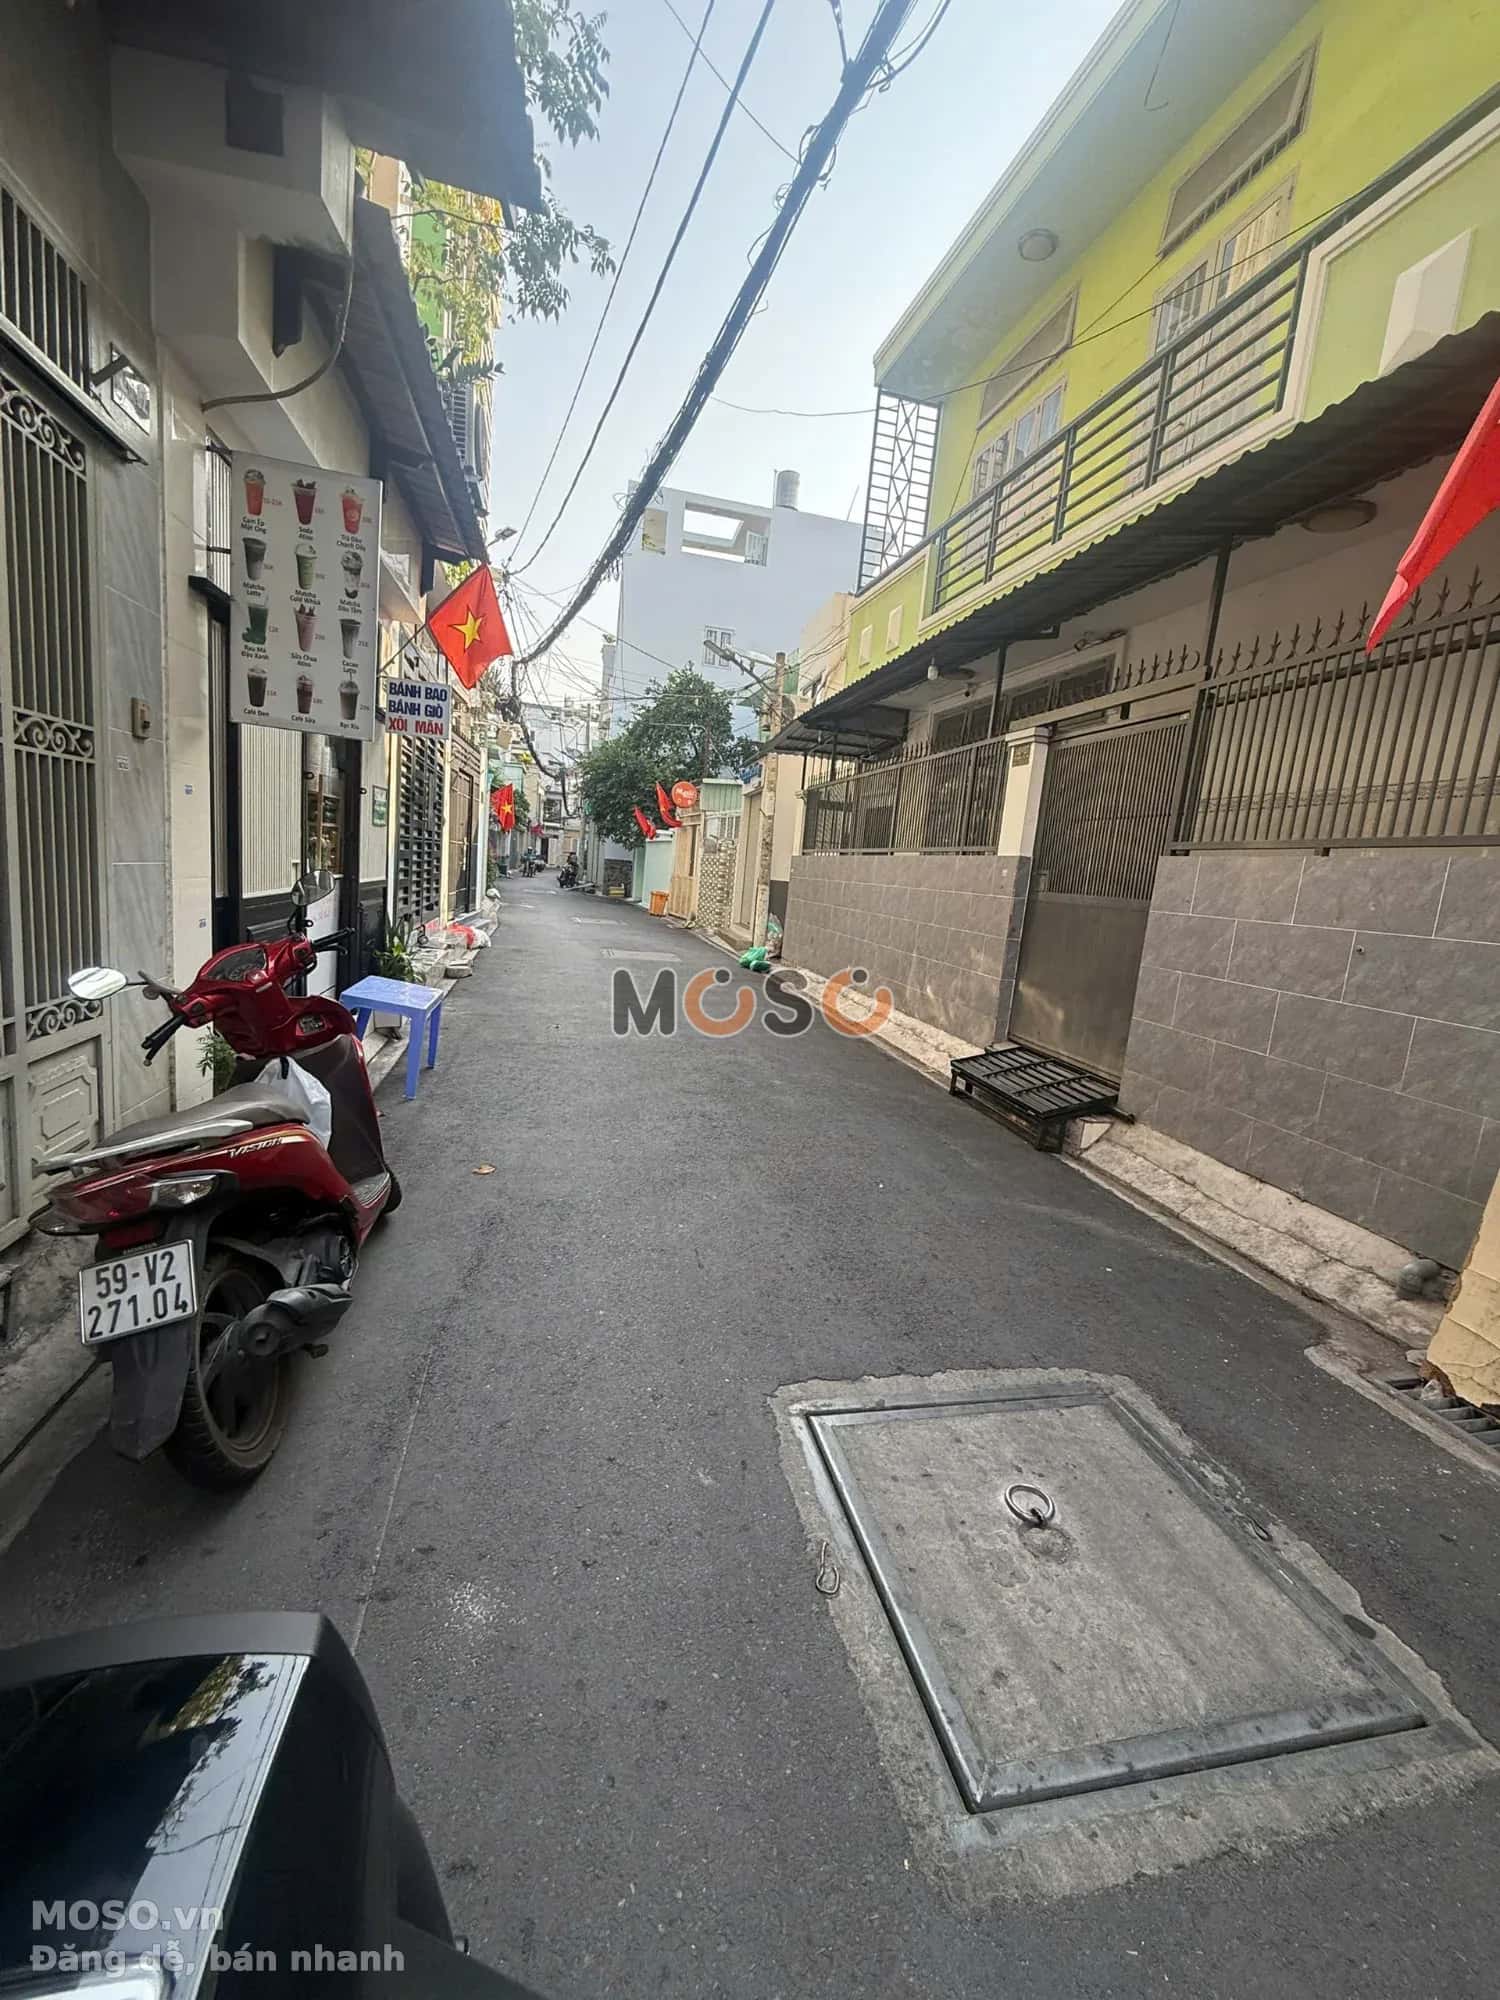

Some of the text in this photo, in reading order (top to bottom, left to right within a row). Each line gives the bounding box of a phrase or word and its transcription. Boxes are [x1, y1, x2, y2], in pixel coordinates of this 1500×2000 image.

[388, 681, 448, 702] BÁNH BAO
[388, 699, 421, 716] BÁNH
[95, 1250, 176, 1299] 59-V2
[87, 1283, 188, 1339] 271.04
